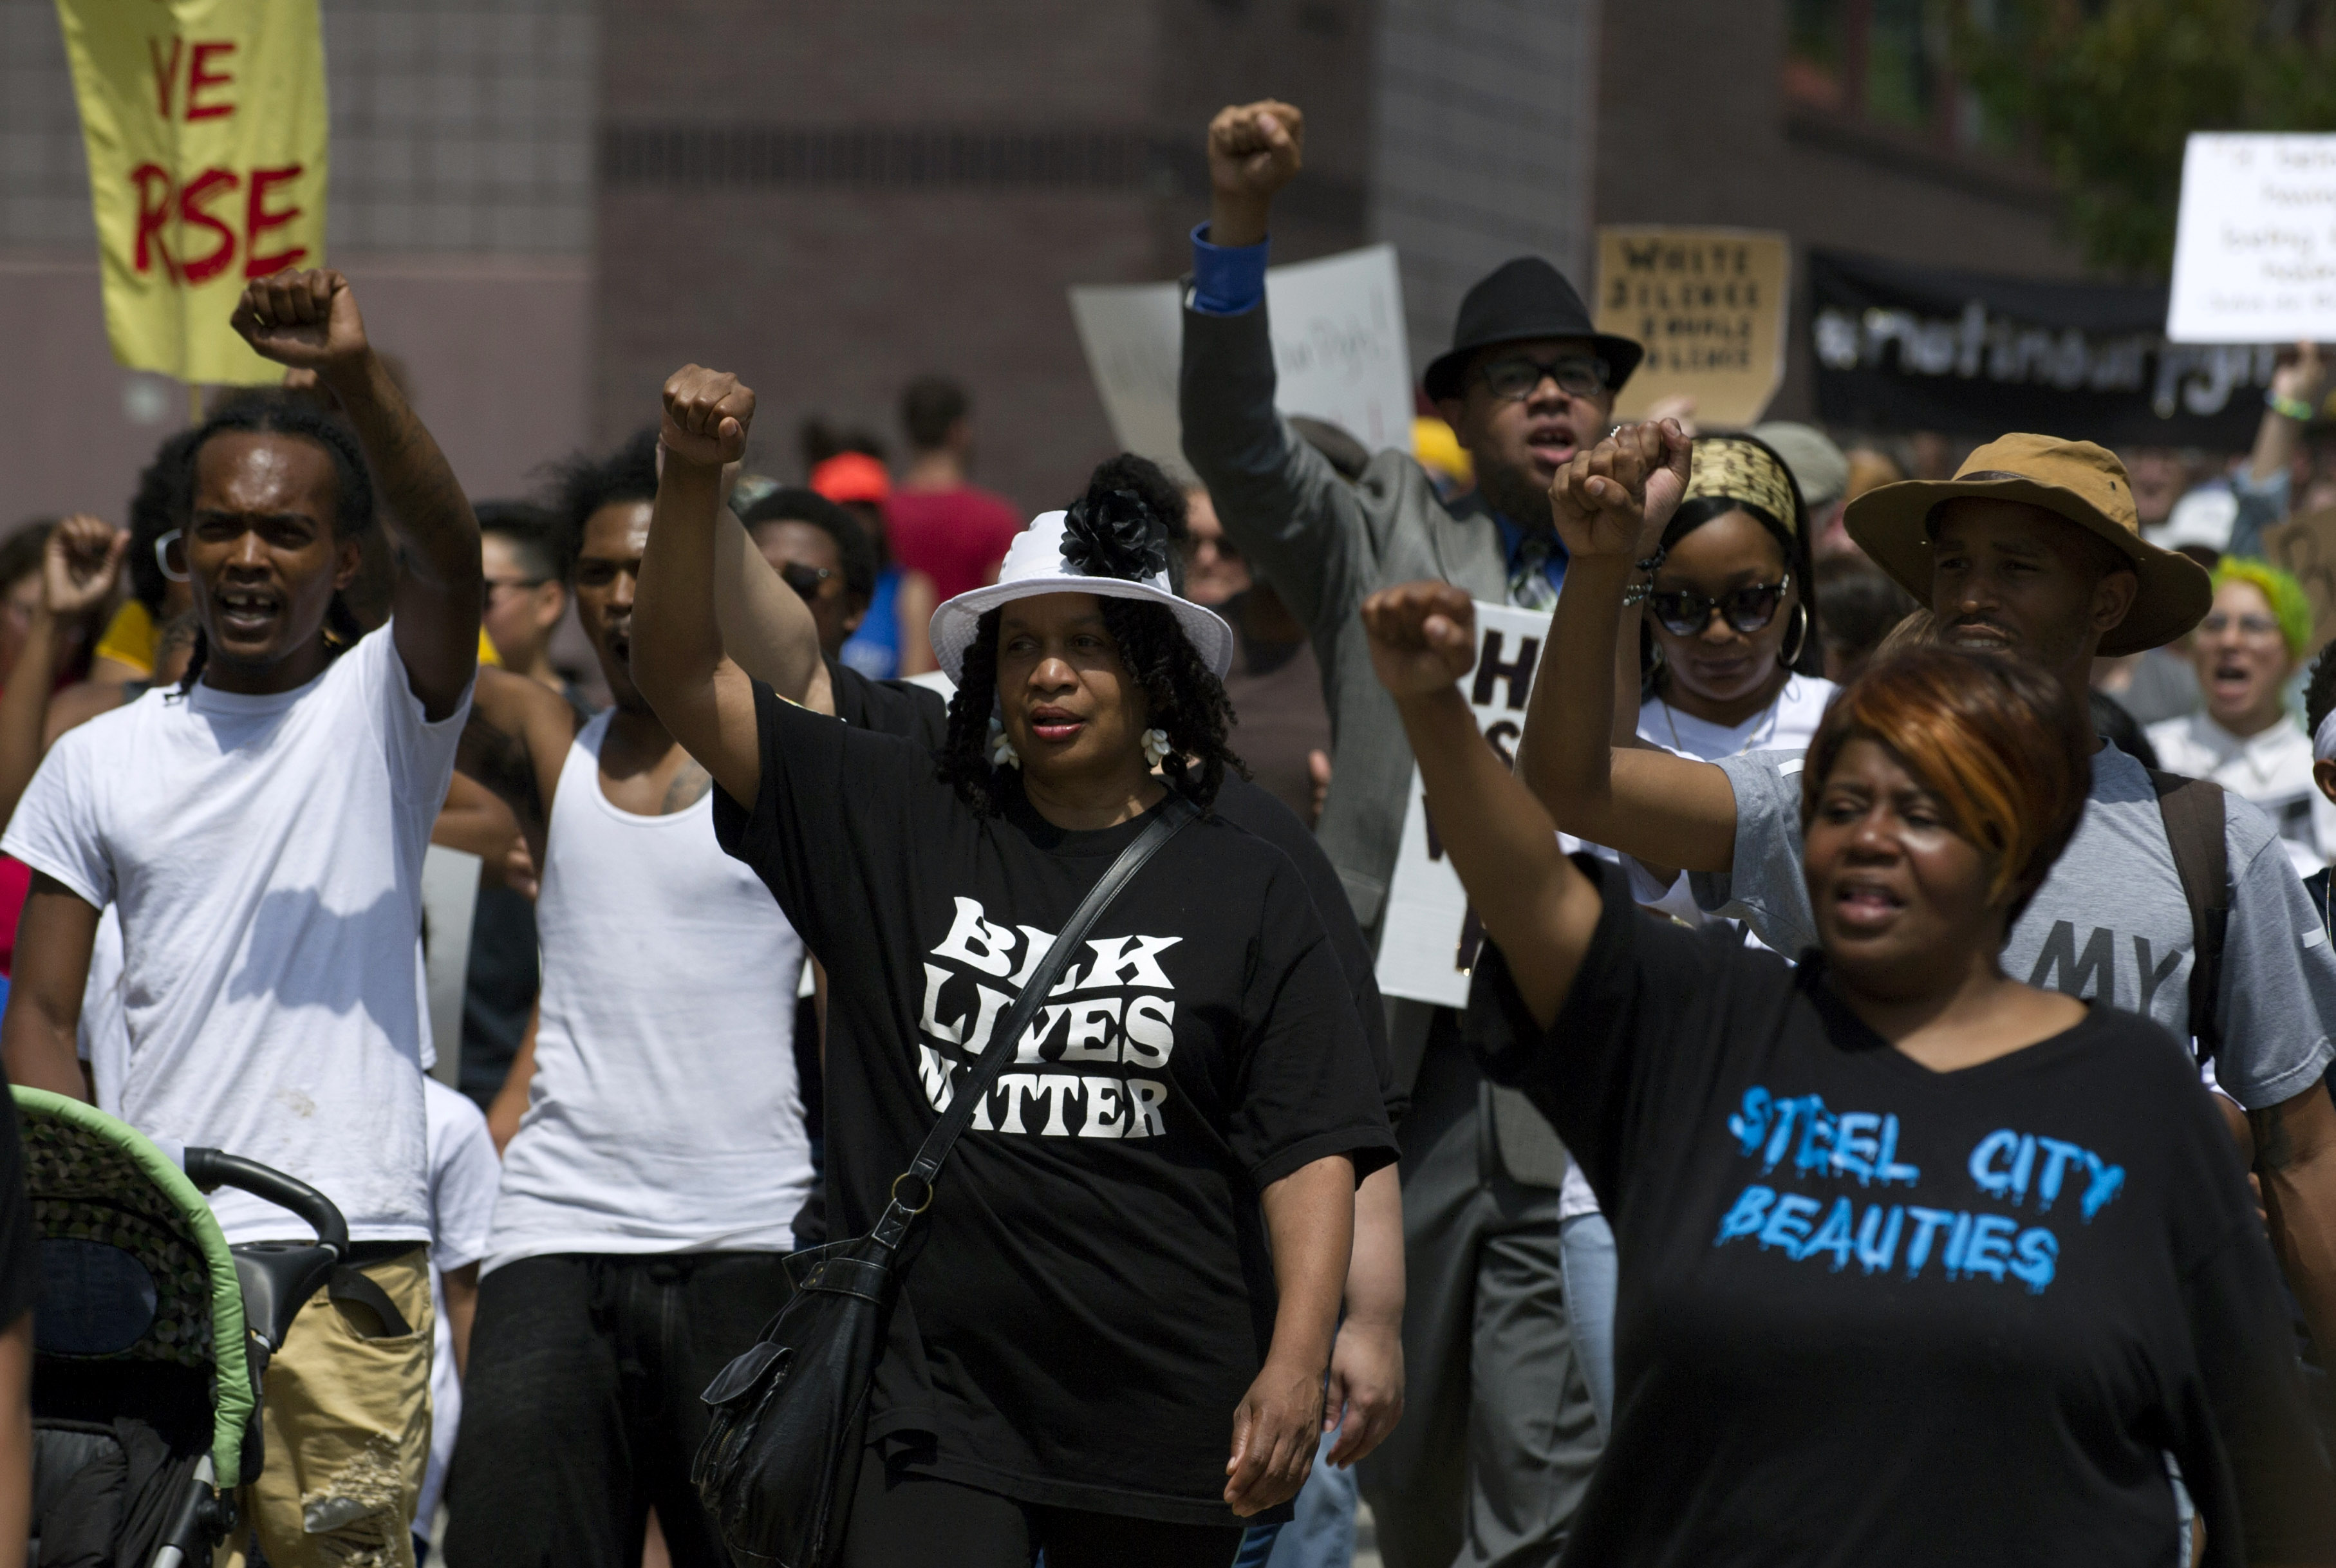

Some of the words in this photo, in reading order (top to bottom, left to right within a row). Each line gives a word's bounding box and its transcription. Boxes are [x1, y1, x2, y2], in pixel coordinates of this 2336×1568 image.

[1609, 276, 1760, 309] SILENCE
[1620, 238, 1749, 275] WHITE
[1647, 346, 1750, 372] OLENCE
[930, 896, 1184, 996] BLK
[919, 962, 1176, 1069] LIVES
[1727, 1085, 1921, 1188] STEEL
[1968, 1128, 2126, 1225] CITY
[1714, 1184, 2060, 1295] BEAUTIES
